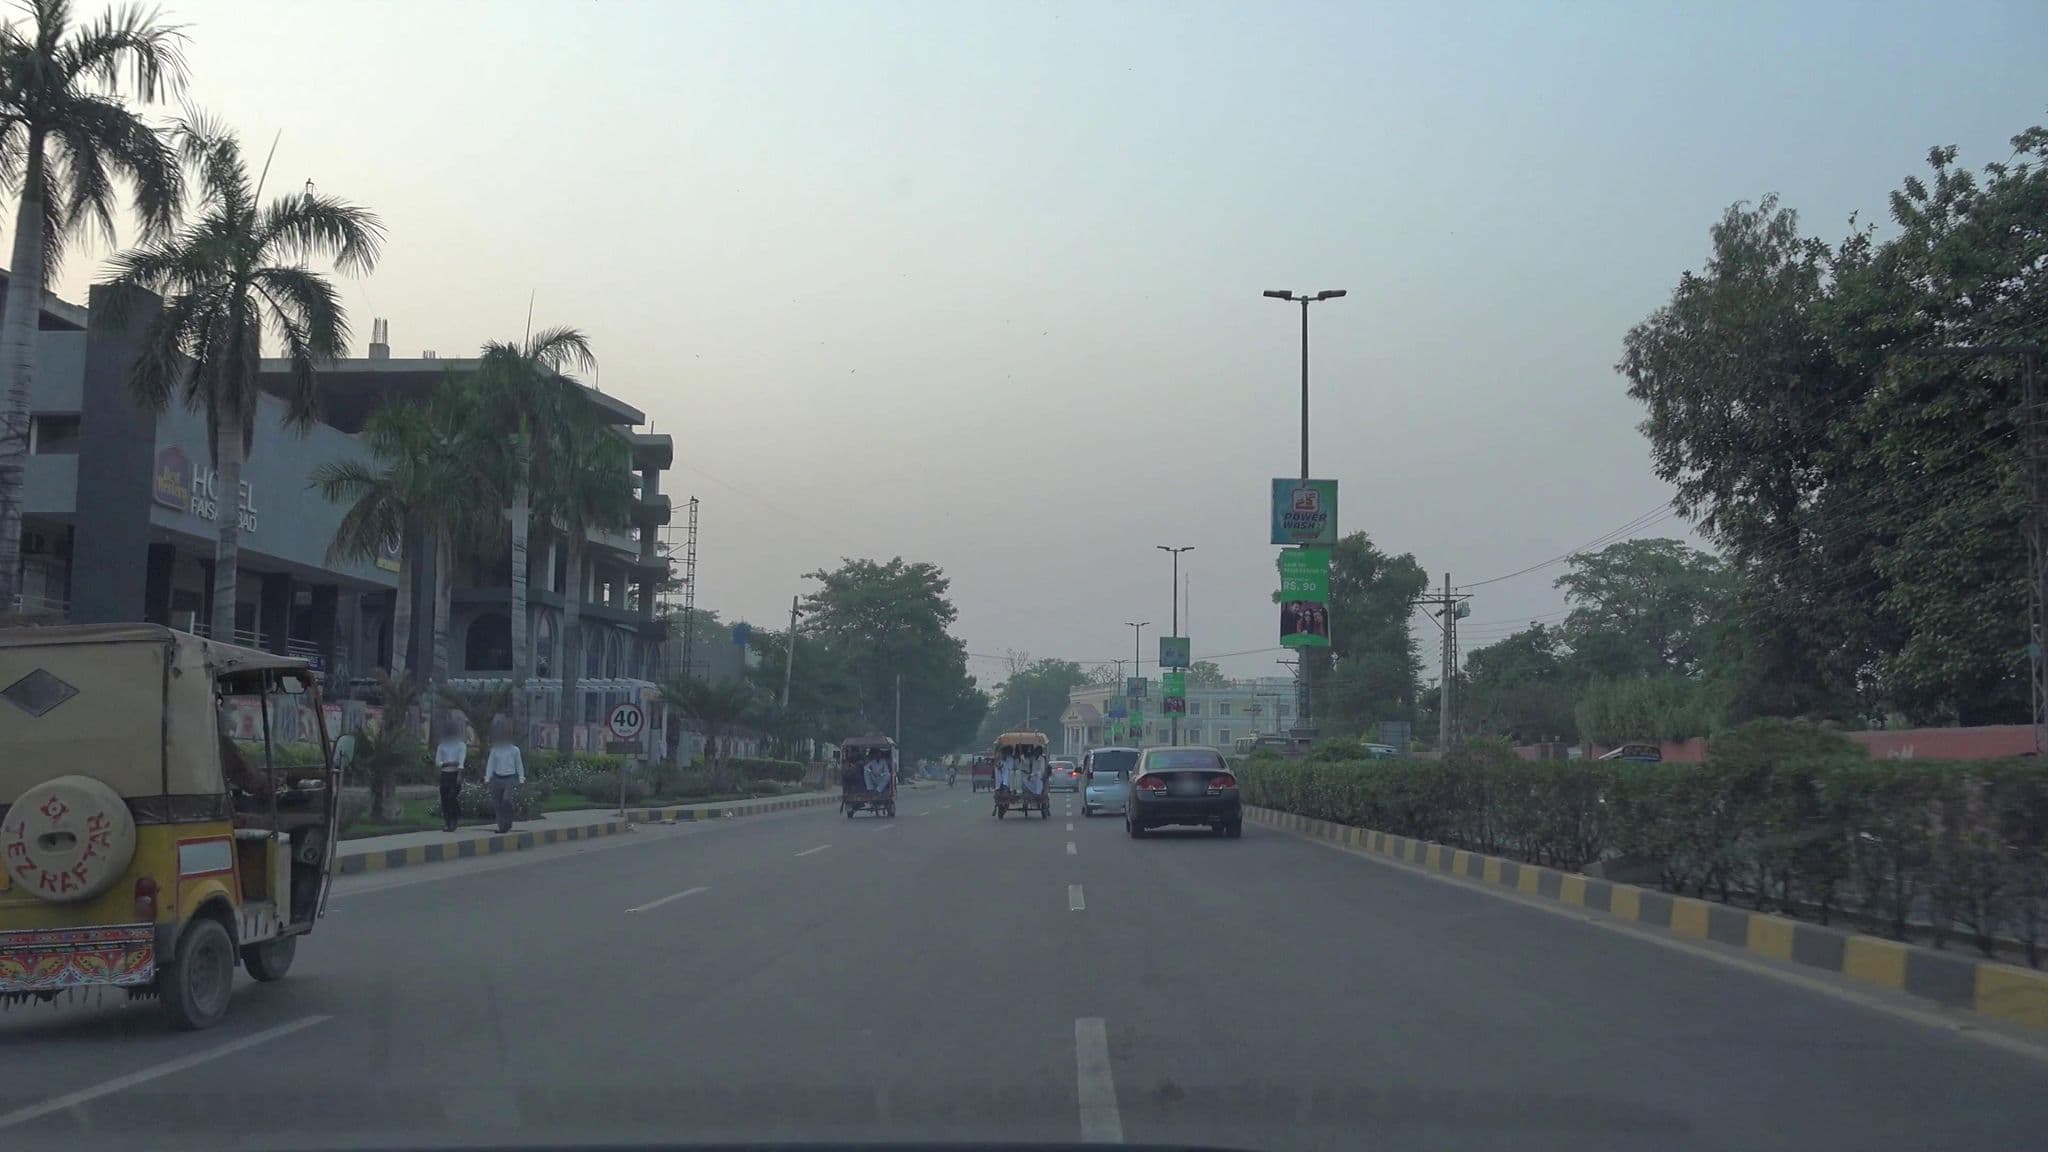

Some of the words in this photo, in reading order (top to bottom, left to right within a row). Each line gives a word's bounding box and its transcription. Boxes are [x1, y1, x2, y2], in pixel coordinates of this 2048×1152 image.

[191, 464, 257, 513] HOEL
[191, 496, 257, 532] FAISBAD
[1284, 512, 1327, 521] POWER
[1283, 520, 1316, 529] WASH
[1303, 582, 1316, 591] 90
[614, 710, 638, 727] 40
